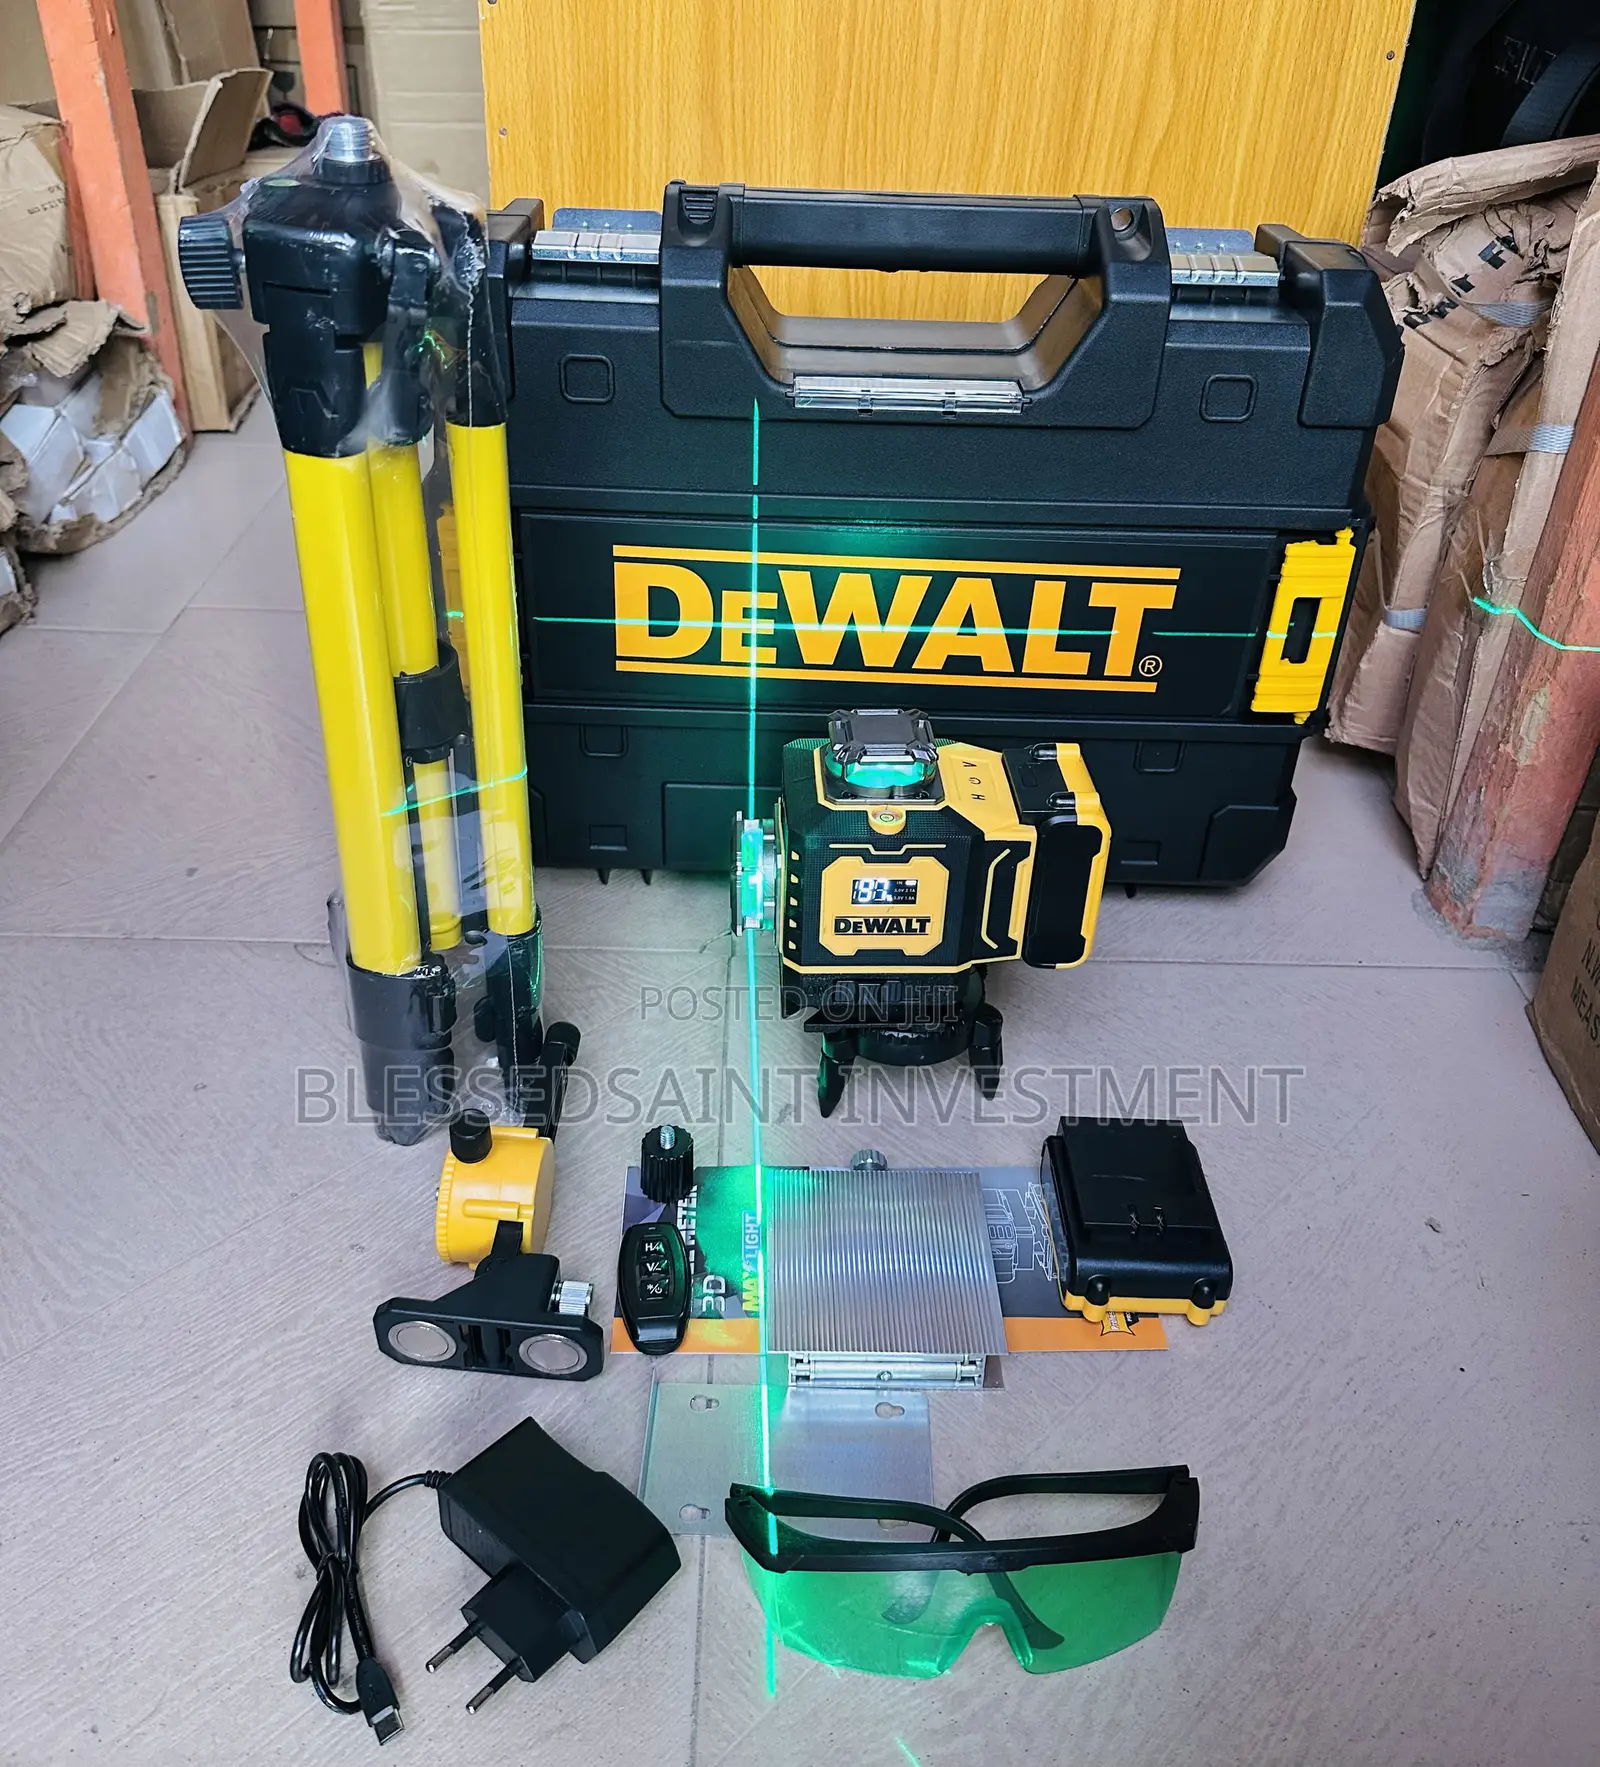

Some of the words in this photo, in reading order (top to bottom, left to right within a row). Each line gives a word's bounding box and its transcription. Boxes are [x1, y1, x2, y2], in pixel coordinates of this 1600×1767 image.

[613, 561, 1177, 677] DEWALT
[833, 918, 931, 935] DEWALT
[702, 1274, 726, 1313] 3D
